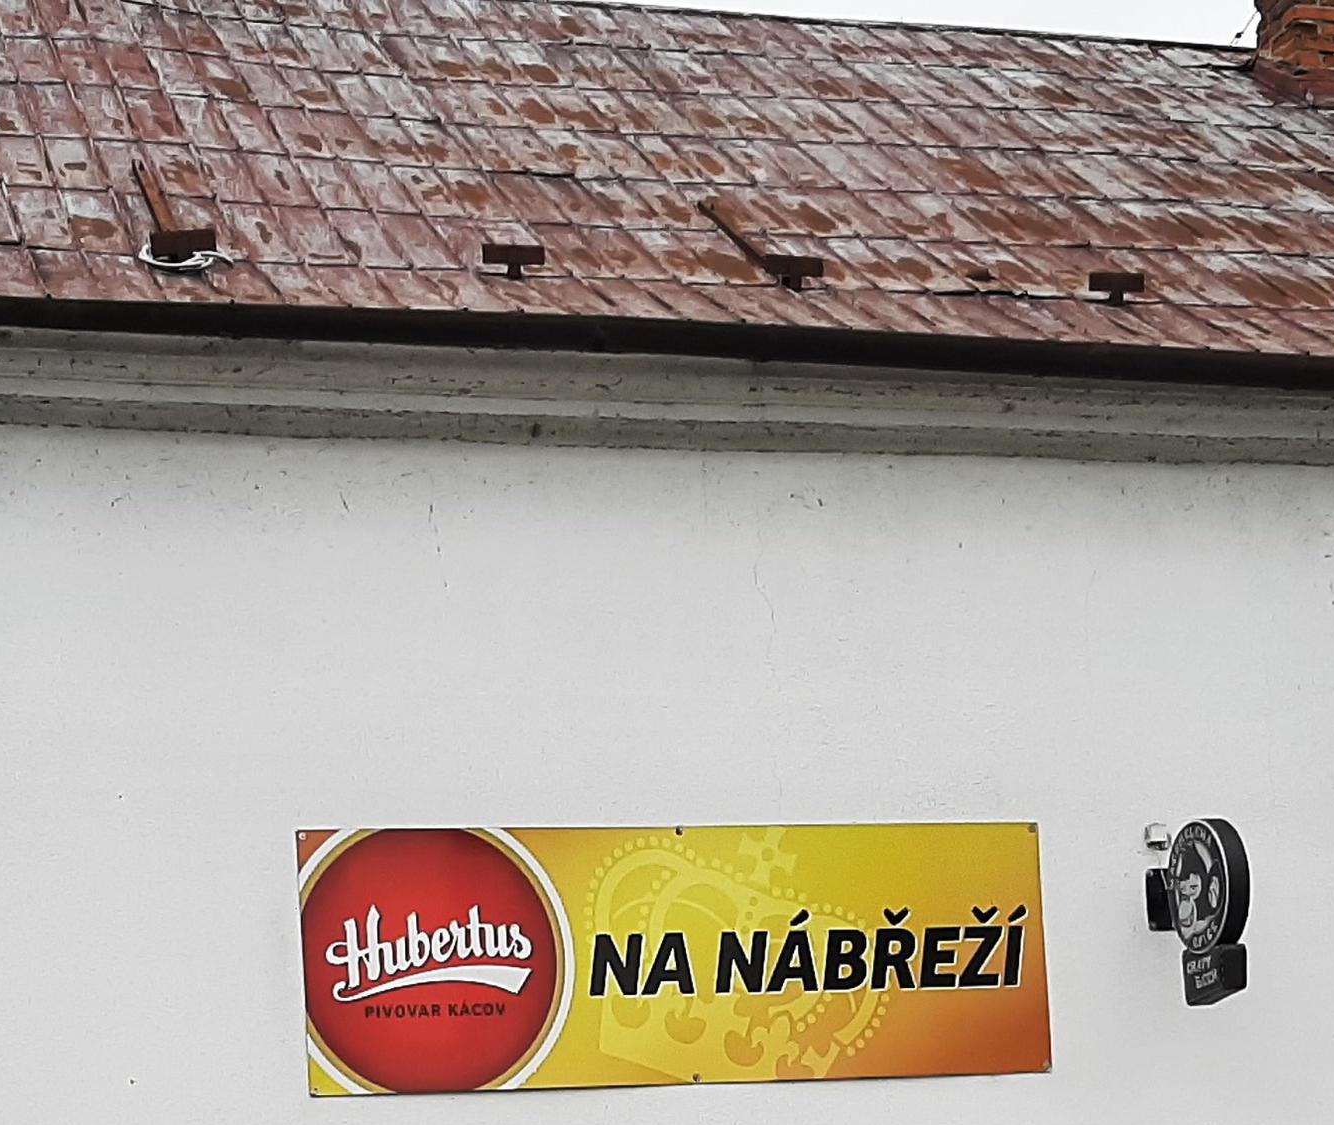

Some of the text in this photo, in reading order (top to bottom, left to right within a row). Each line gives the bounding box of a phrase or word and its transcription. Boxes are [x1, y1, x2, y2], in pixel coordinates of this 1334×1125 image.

[325, 903, 533, 989] Hubertus
[589, 904, 1029, 997] NA NÁBŘEŽÍ
[364, 1000, 506, 1019] PIVOVAR KÁCOV
